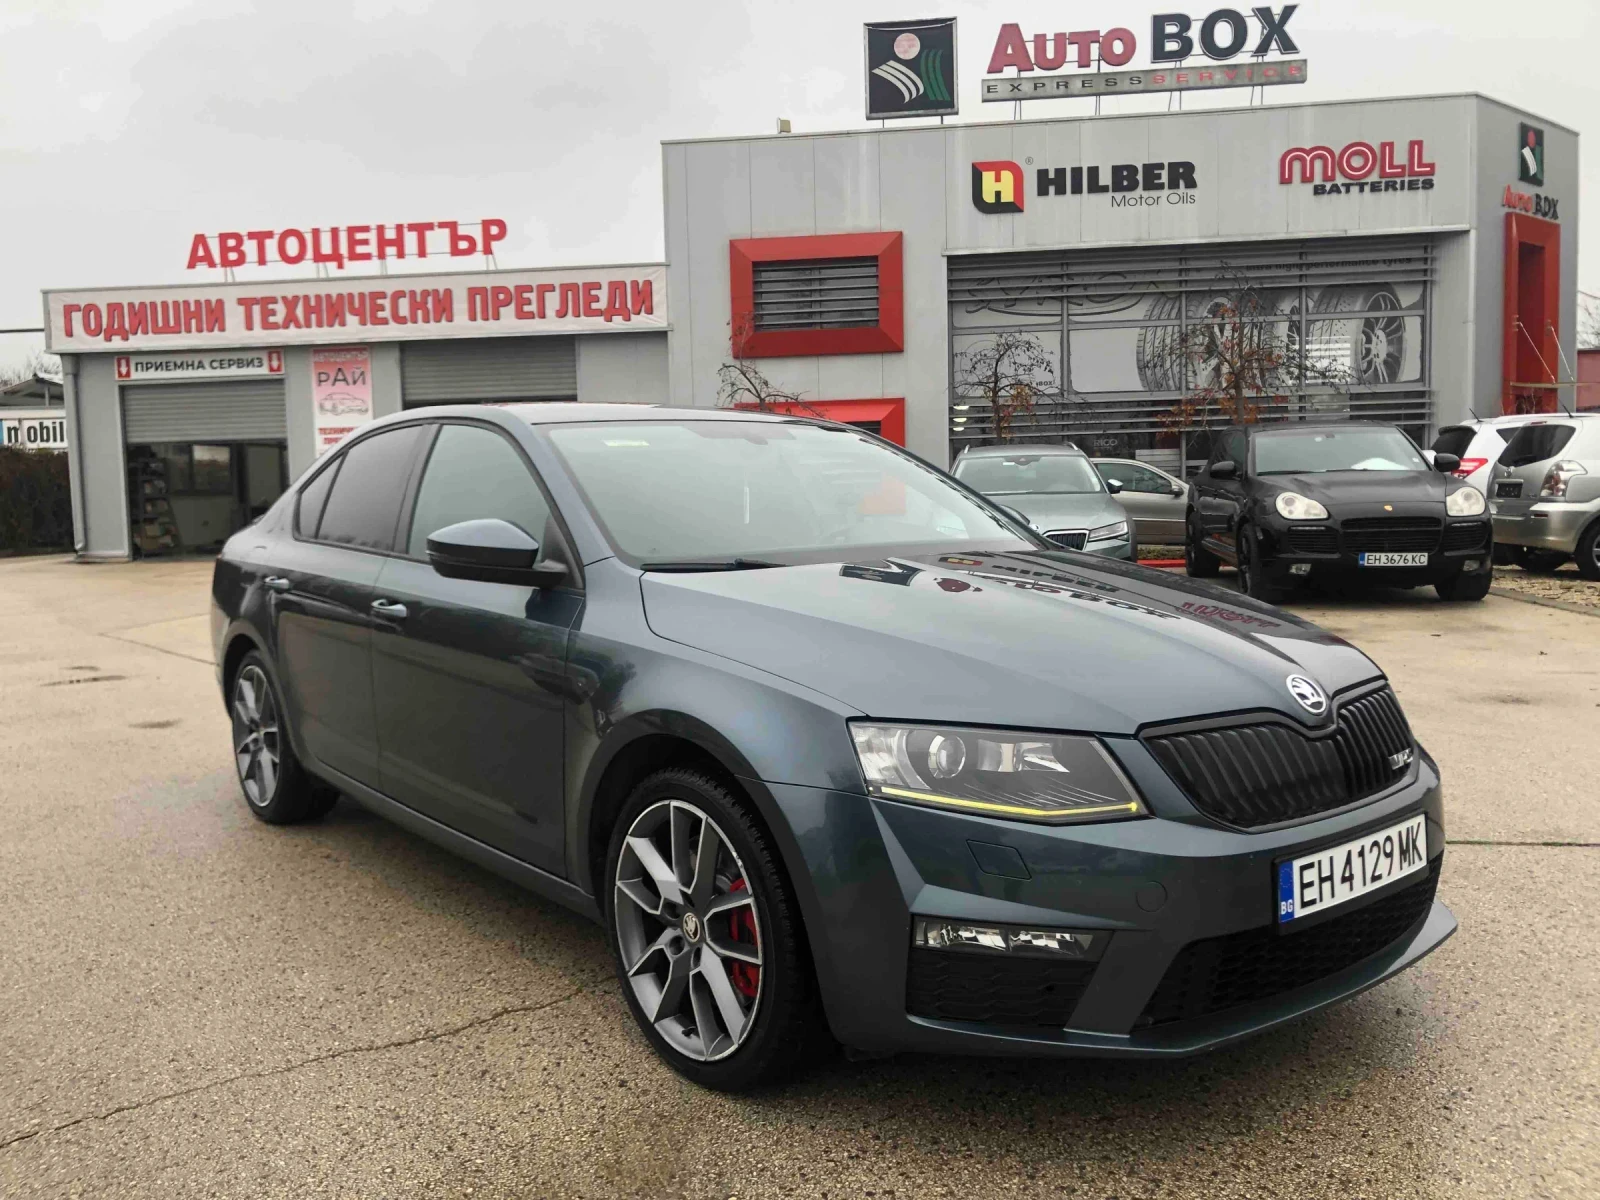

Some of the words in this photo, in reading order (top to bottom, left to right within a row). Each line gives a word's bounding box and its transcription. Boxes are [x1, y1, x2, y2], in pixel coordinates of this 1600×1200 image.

[1151, 4, 1301, 63] BOX
[986, 76, 1143, 94] EXPRESS
[1152, 65, 1302, 84] SERVICE
[1279, 139, 1436, 186] MOLL
[1036, 161, 1198, 197] HILBER
[1313, 176, 1435, 196] BATTERIES
[1111, 194, 1161, 208] Motor
[1166, 192, 1196, 205] Oils
[1533, 193, 1559, 220] BOX
[186, 219, 509, 270] АВТОЦЕНТЪР
[63, 297, 226, 342] ГОДИШНИ
[237, 288, 453, 331] ТЕХНИЧЕСКИ
[467, 280, 653, 322] ПРЕГЛЕДИ
[134, 359, 206, 373] ПРИЕМНА
[209, 356, 264, 370] СЕРВИЗ
[317, 366, 366, 387] РАЙ
[1366, 554, 1382, 565] EH
[1383, 554, 1410, 565] 3676
[1411, 554, 1426, 565] KC
[1299, 856, 1335, 909] EH
[1340, 835, 1395, 892] 4129
[1399, 822, 1423, 872] MK
[1280, 900, 1294, 916] BG
